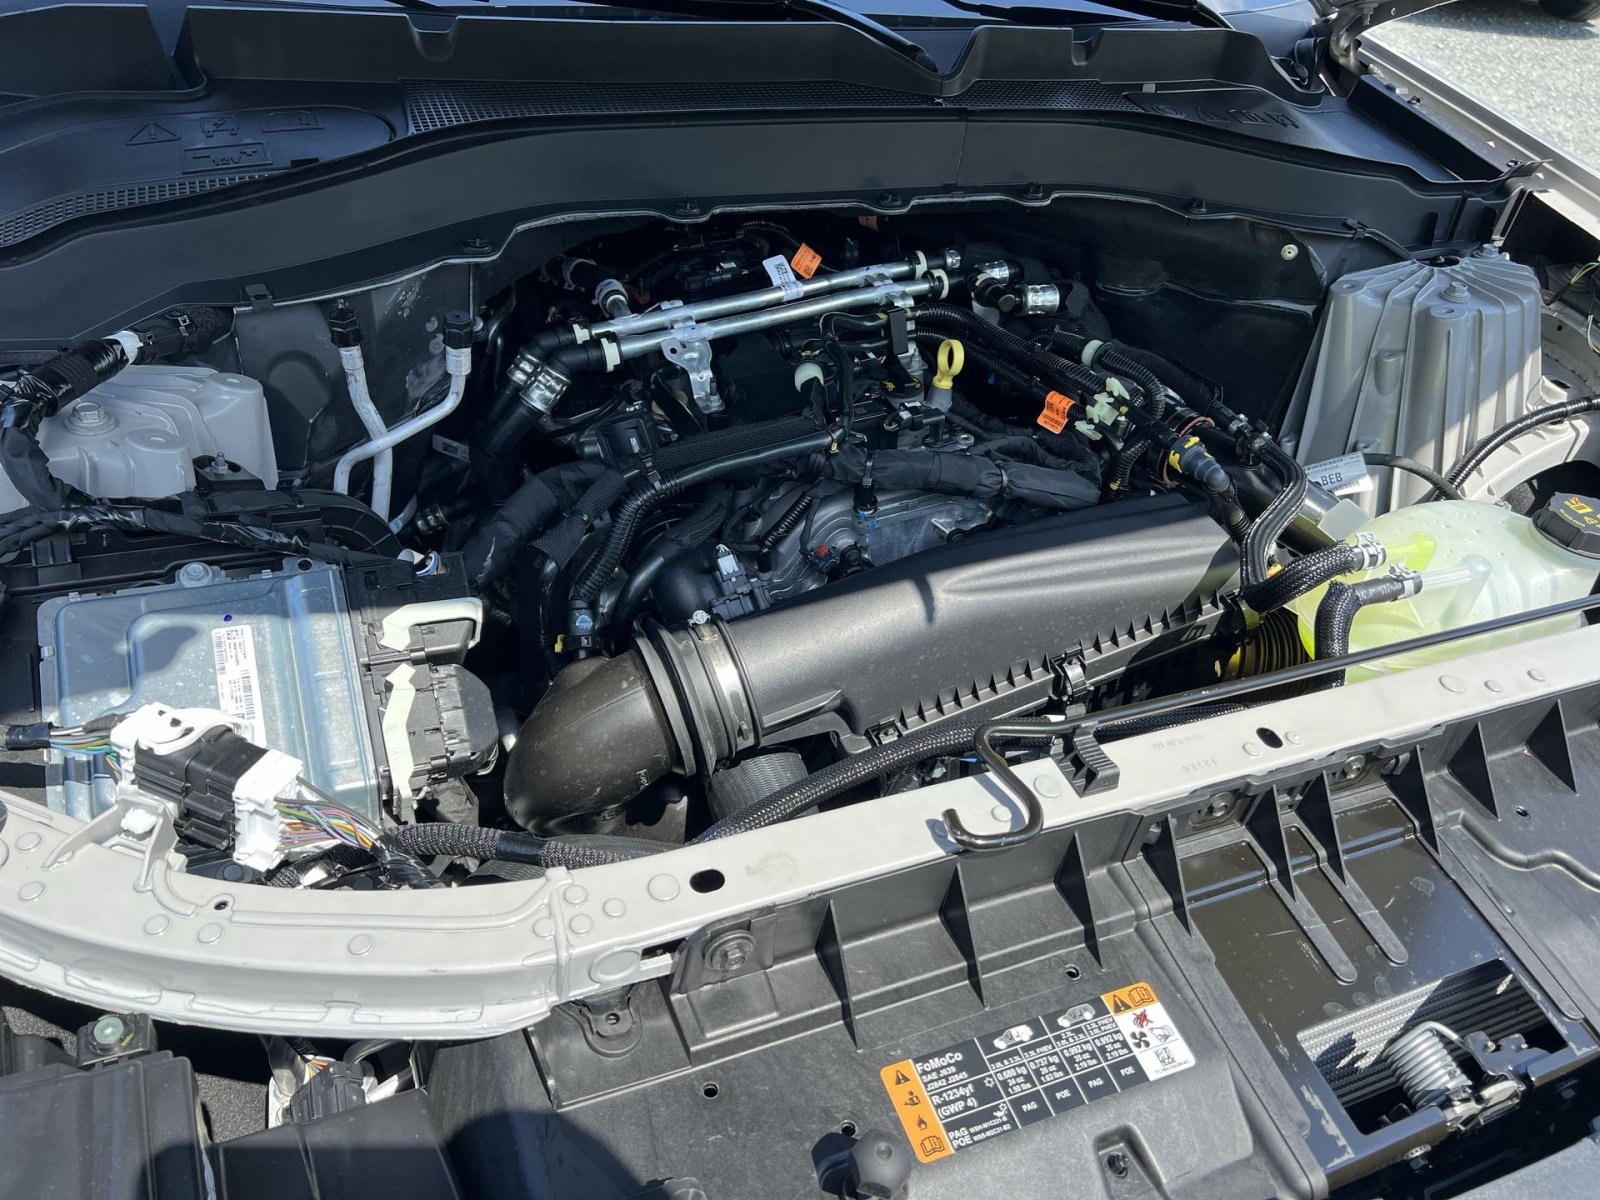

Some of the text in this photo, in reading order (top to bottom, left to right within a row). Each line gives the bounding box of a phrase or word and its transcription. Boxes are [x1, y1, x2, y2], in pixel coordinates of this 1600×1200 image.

[1321, 472, 1343, 486] BEB
[1094, 1032, 1124, 1047] 0.992 kg
[1036, 1044, 1052, 1054] FHEV
[1063, 1042, 1093, 1058] 0.992 kg
[1105, 1051, 1119, 1060] 2.19
[916, 1052, 963, 1074] FoMoCo
[1029, 1054, 1060, 1070] 0.737 kg
[1074, 1062, 1088, 1071] 2.19
[921, 1066, 957, 1083] SAE J639
[996, 1066, 1028, 1081] 0.680 kg
[1120, 1066, 1136, 1077] POE
[926, 1071, 968, 1092] J2842 J2845
[1007, 1078, 1016, 1086] 24
[1040, 1074, 1054, 1083] 1.63
[1088, 1077, 1104, 1088] PAG
[931, 1083, 975, 1105] R-1234yf
[1055, 1089, 1071, 1100] POE
[938, 1097, 978, 1119] (GWP 4)
[1021, 1101, 1038, 1112] PAG
[948, 1127, 968, 1140] PAG
[952, 1135, 973, 1148] POE
